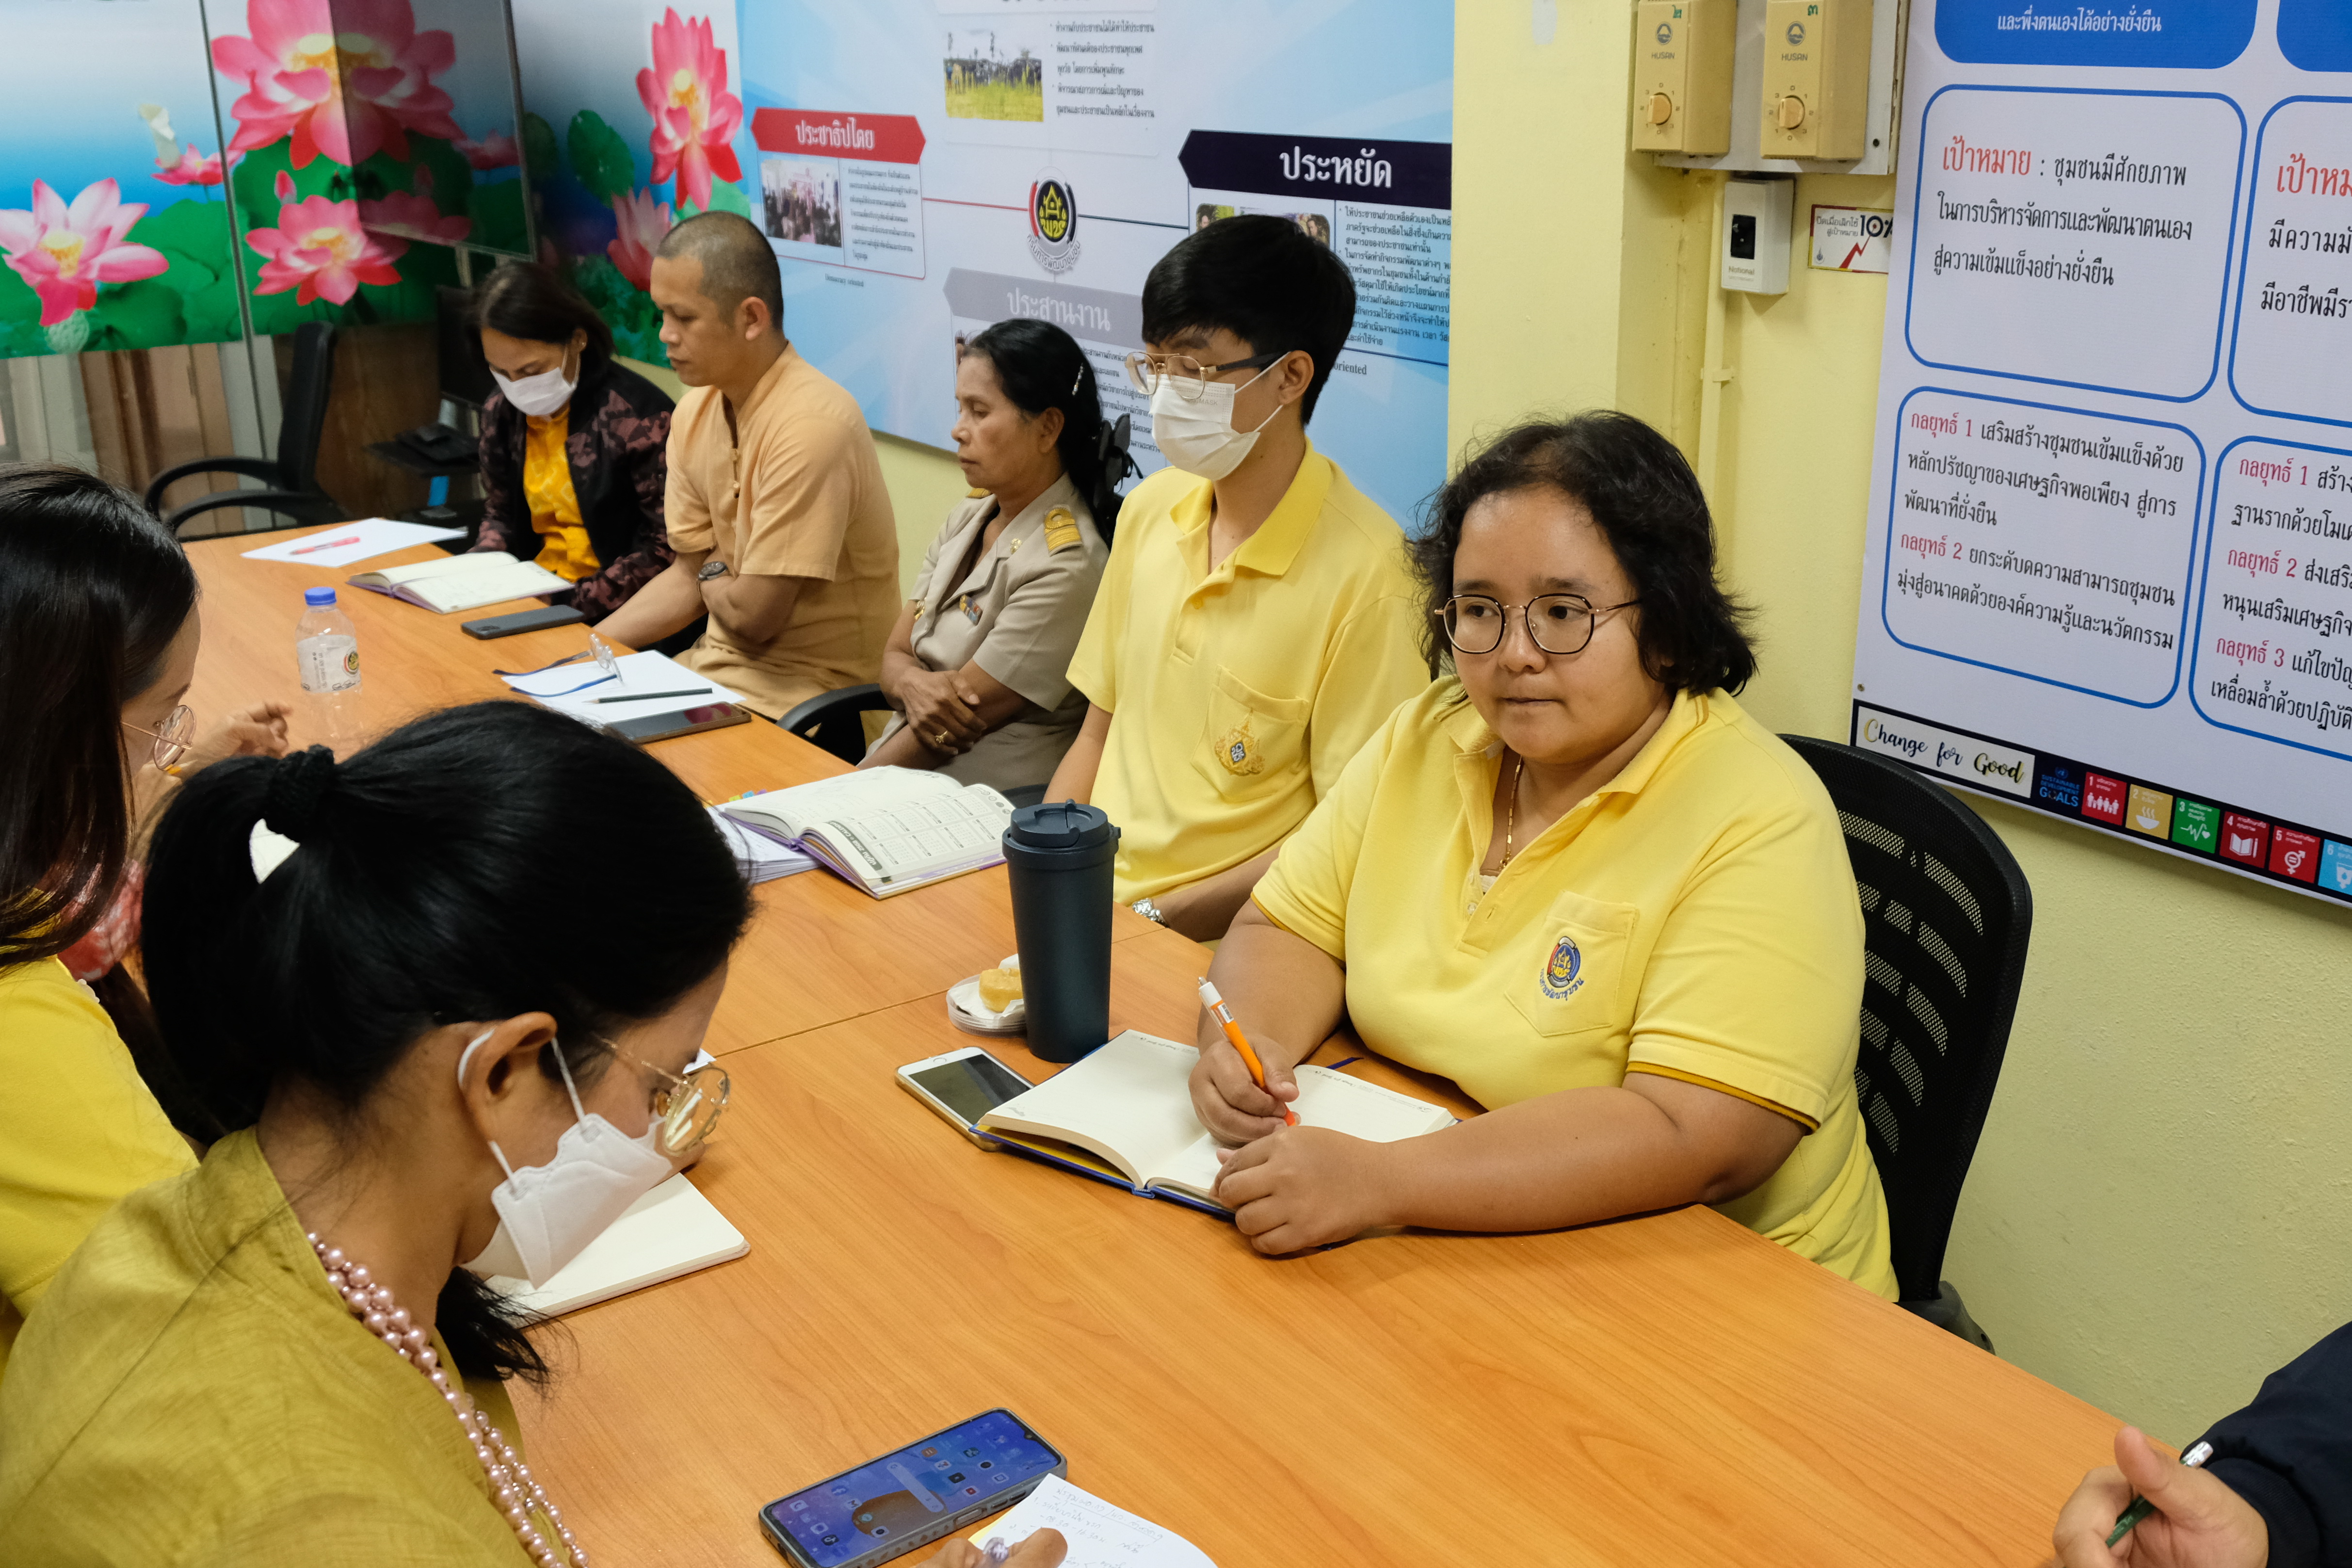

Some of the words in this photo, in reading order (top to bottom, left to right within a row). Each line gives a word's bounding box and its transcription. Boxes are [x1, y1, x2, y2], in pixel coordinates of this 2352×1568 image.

[1997, 4, 2162, 32] และพึ่งตนเองได้อย่างยั่งยืน
[1279, 145, 1392, 189] ประหยัด
[1942, 135, 2031, 175] เป้าหมาย
[2054, 153, 2187, 186] ชุมชนมีศักยภาพ
[1937, 191, 2192, 241] ในการบริหารจัดการและพัฒนาตนเอง
[1933, 243, 2114, 285] สู่ความเข้มแข็งอย่างยั่งยืน
[1007, 287, 1111, 331] ประสานงาน
[1911, 412, 1959, 438] กลยุทธ์
[1965, 419, 1972, 437] 1
[1981, 420, 2184, 472] เสริมสร้างชุมชนเข้มแข็งด้วย
[2239, 457, 2294, 487] กลยุทธ์
[2300, 465, 2307, 485] 1
[1905, 489, 1997, 526] พัฒนาที่ยั่งยืน
[2137, 489, 2176, 518] สู่การ
[1901, 534, 1948, 559] กลยุทธ์
[1953, 542, 1962, 560] 2
[2227, 550, 2281, 578] กลยุทธ์
[2286, 558, 2297, 578] 2
[1898, 568, 2174, 650] มุ่งสู่อนาคตด้วยองค์ความรู้และนวัตกรรม
[2216, 638, 2269, 666] กลยุทธ์
[2274, 648, 2285, 667] 3
[1864, 718, 1928, 758] Change
[1936, 742, 1963, 767] for
[1974, 753, 2024, 784] Good
[2040, 780, 2079, 795] DEVELOPMENT
[2041, 775, 2079, 790] SUSTAINABLE
[2179, 801, 2185, 812] 3
[2227, 815, 2233, 826] 4
[2276, 830, 2282, 841] 5
